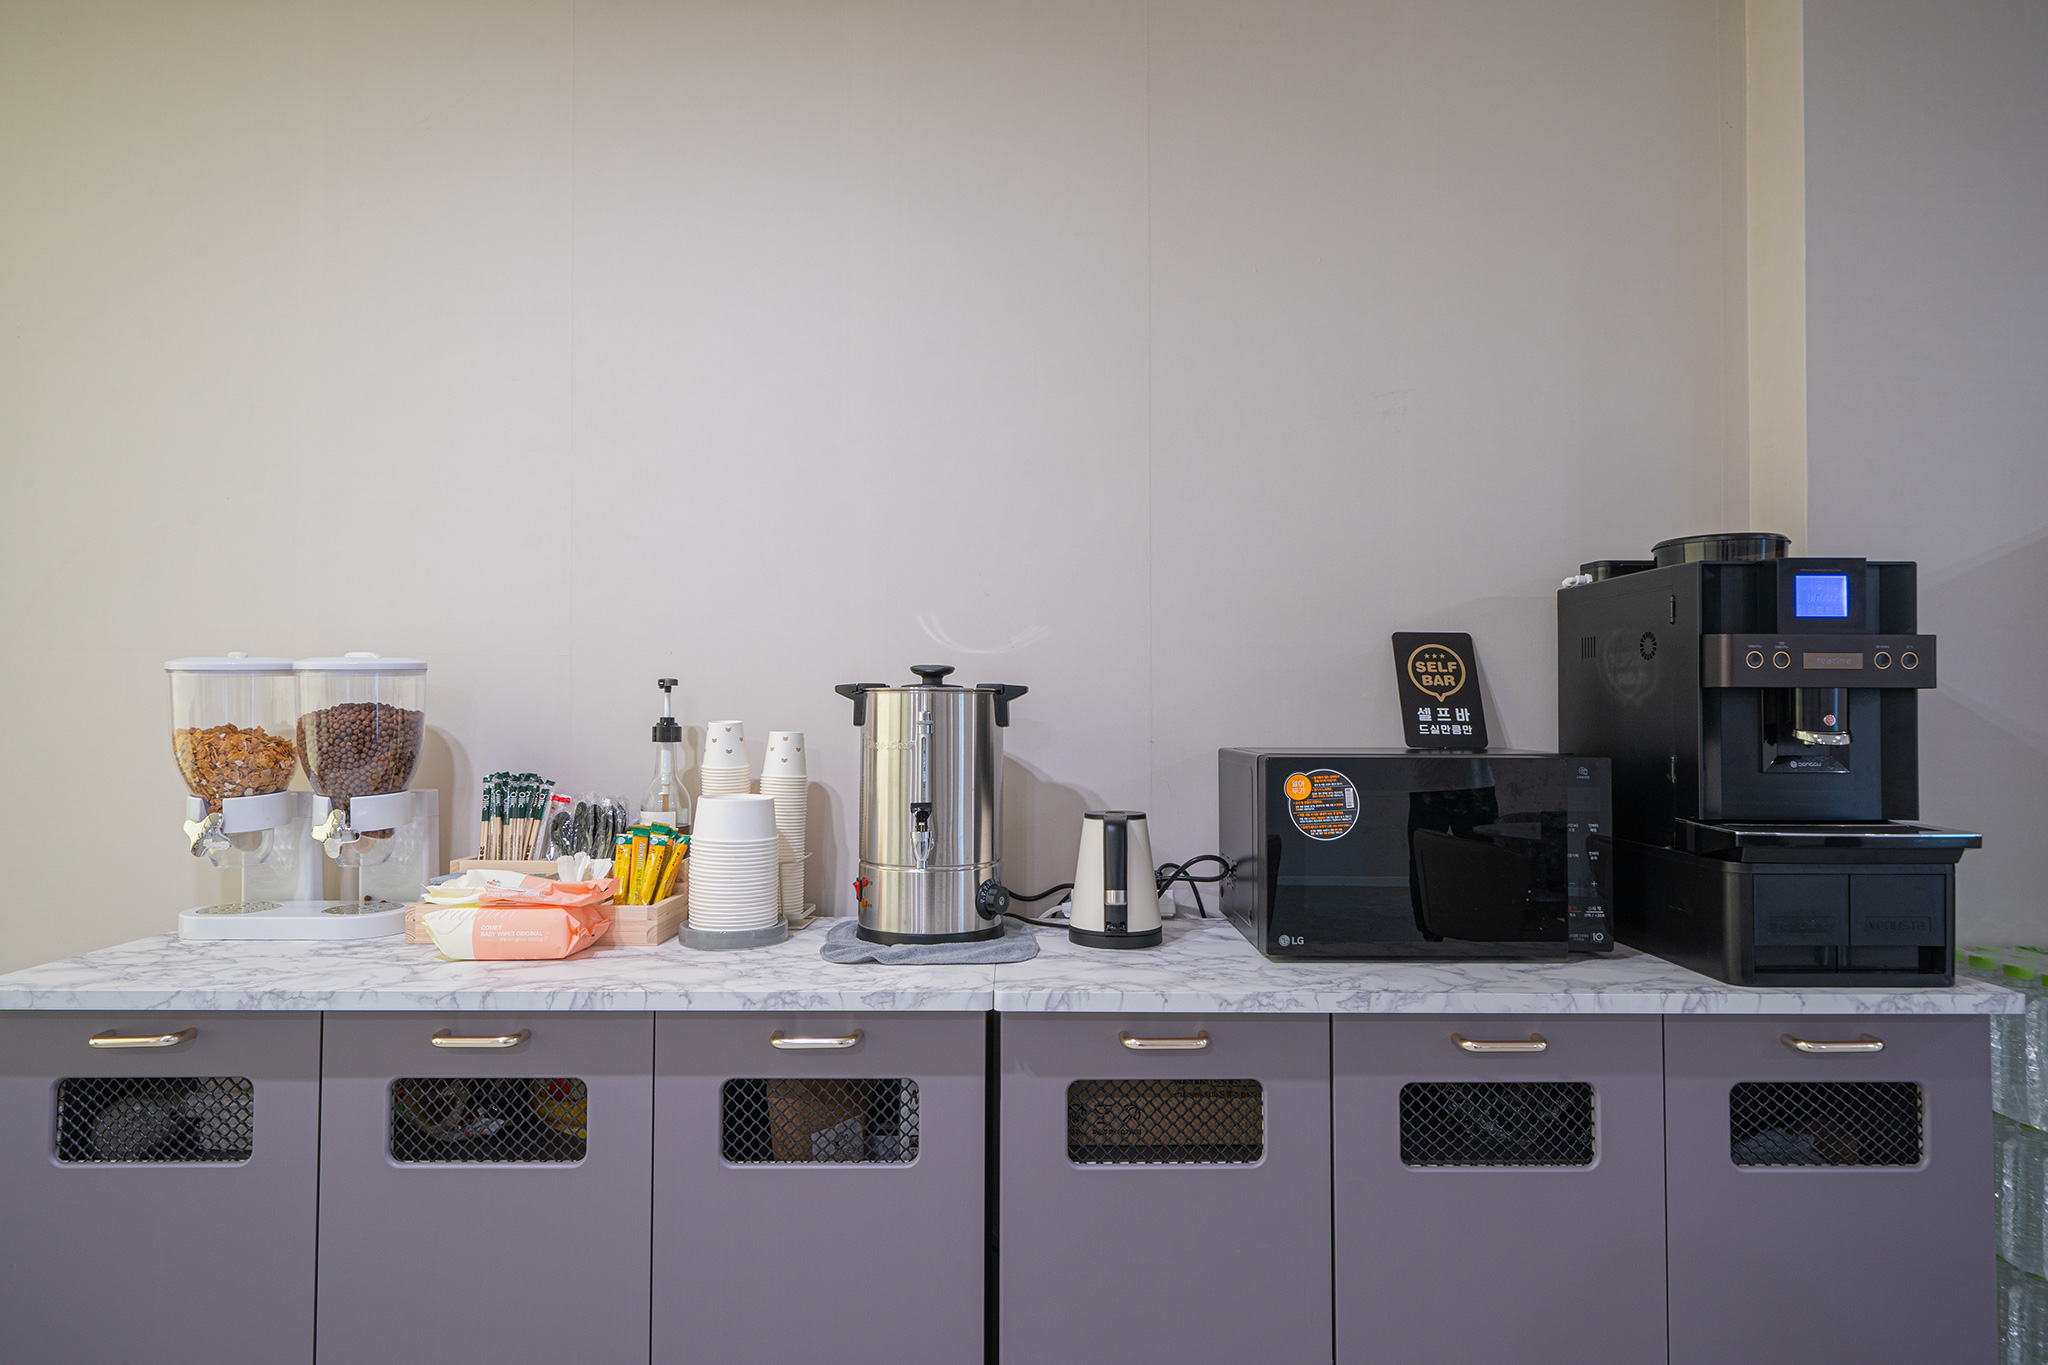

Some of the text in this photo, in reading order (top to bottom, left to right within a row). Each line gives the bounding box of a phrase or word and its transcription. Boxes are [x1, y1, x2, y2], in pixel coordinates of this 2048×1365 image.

[1415, 661, 1457, 673] SELF
[1421, 674, 1456, 686] BAR
[1291, 787, 1306, 795] 두기
[1291, 936, 1305, 945] LG
